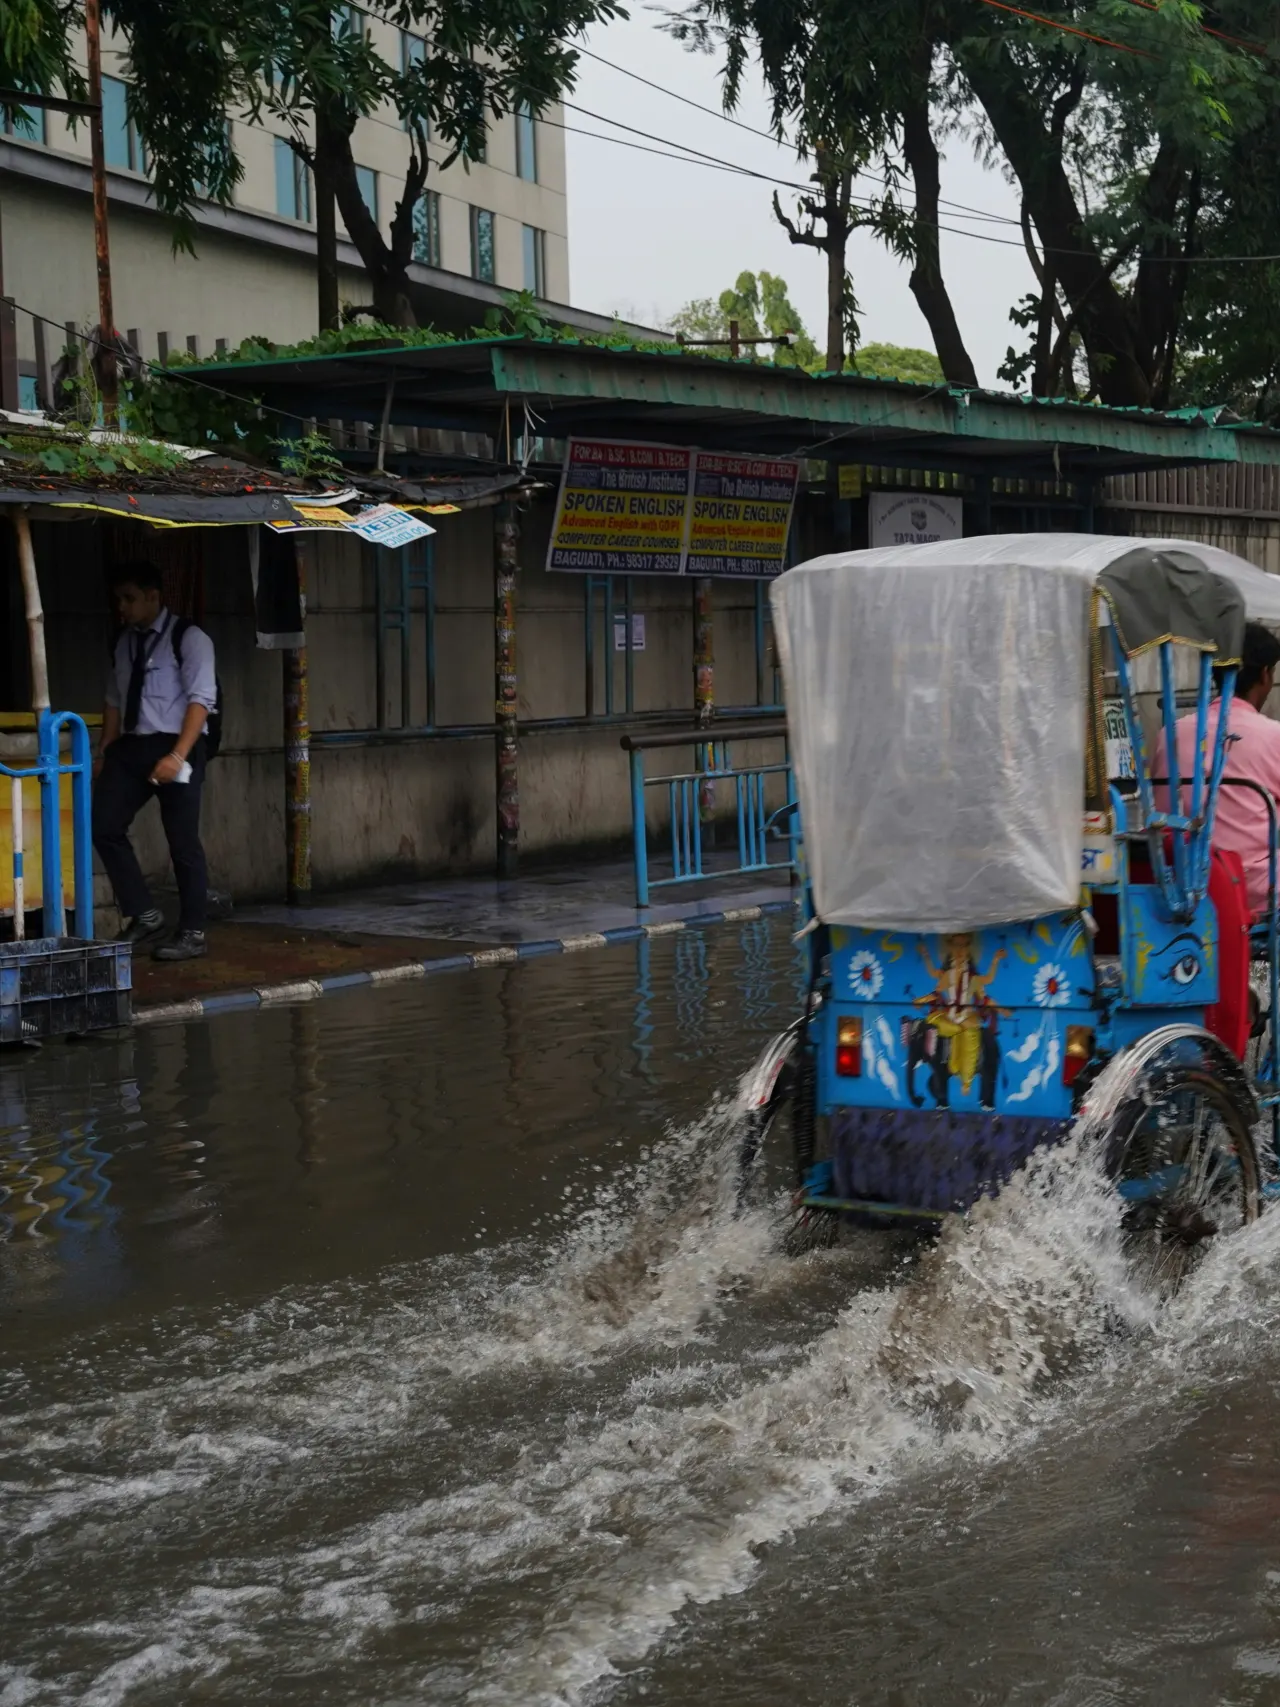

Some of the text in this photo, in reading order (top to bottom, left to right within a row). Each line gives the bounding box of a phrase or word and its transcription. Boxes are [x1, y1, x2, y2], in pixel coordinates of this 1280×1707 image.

[574, 444, 591, 459] FOR
[601, 467, 617, 488] The
[618, 469, 647, 489] British
[648, 471, 687, 492] Institutes
[720, 476, 735, 497] The
[736, 478, 760, 498] British
[760, 480, 793, 501] Institutes
[564, 492, 685, 516] SPOKEN ENGLISH
[694, 501, 788, 524] SPOKEN ENGLISH
[362, 512, 412, 536] NEET
[410, 526, 428, 536] GO
[561, 514, 606, 528] Advanced
[608, 516, 638, 532] English
[640, 520, 657, 531] with
[692, 522, 726, 536] Advanced
[557, 532, 680, 549] COMPUTER CAREER COURSES
[690, 538, 784, 555] COMPUTER CAREER COURSES
[894, 532, 914, 544] TATA
[626, 554, 652, 568] 98317
[654, 555, 680, 570] 29529
